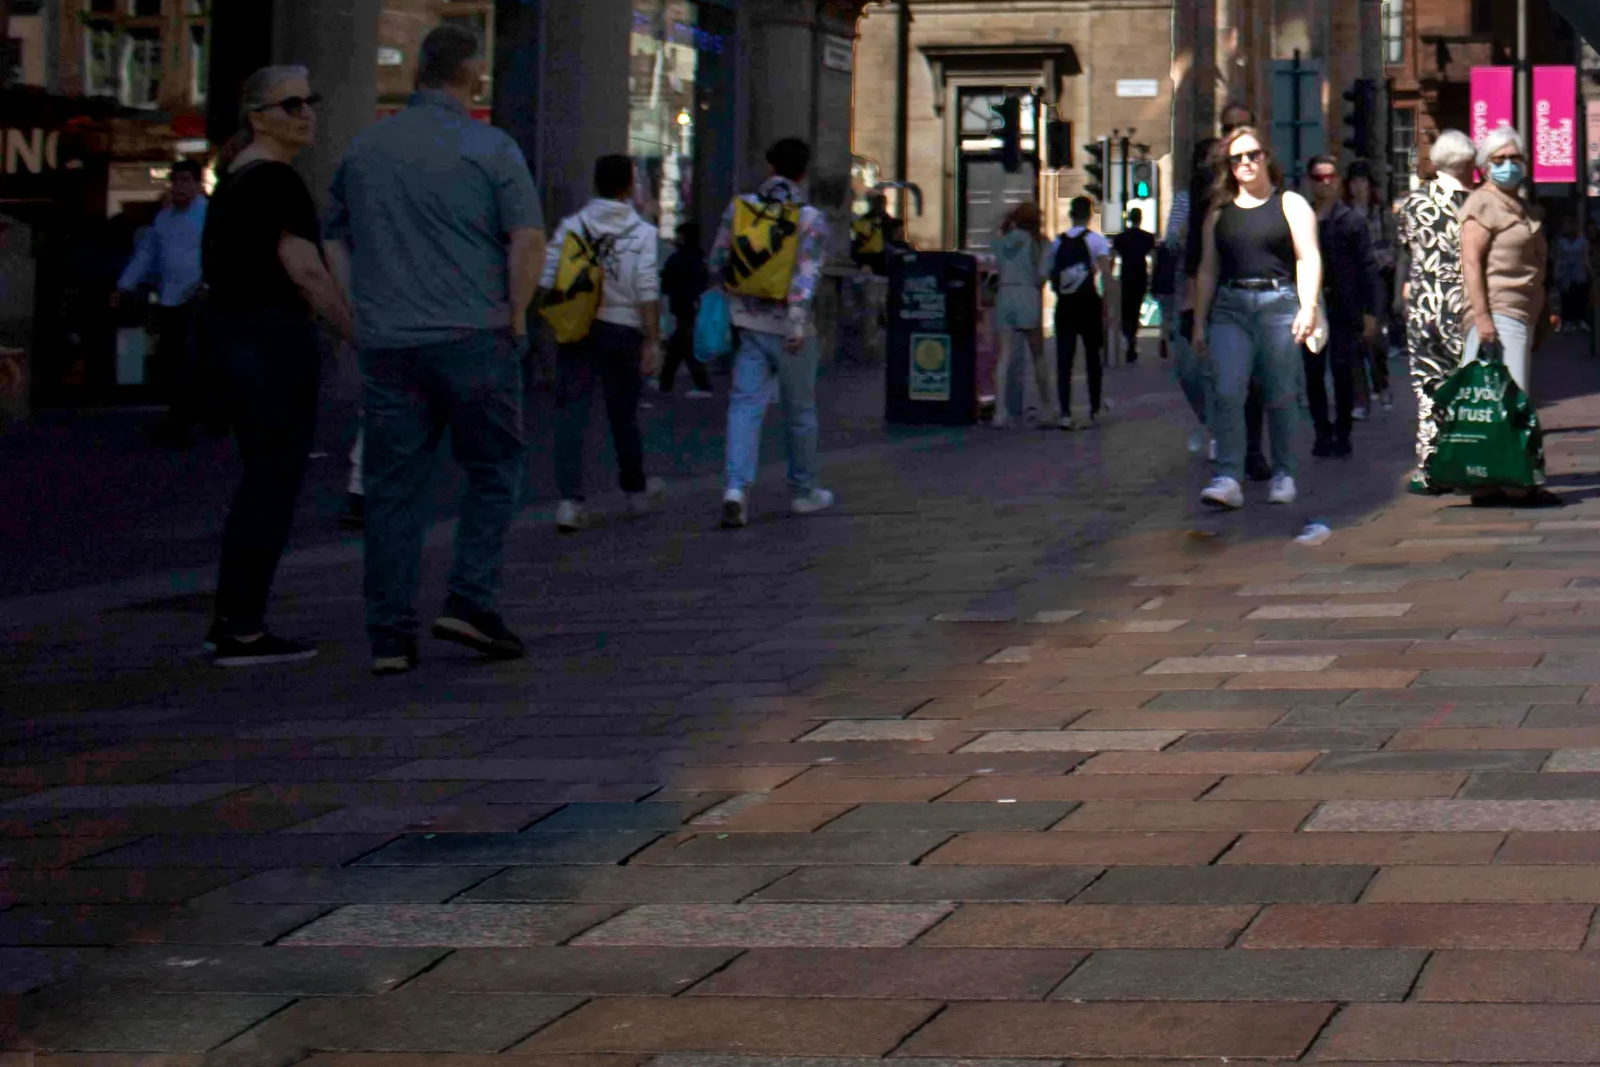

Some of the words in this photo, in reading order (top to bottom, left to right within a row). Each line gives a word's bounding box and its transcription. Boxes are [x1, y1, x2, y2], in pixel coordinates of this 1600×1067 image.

[1537, 100, 1550, 166] GLASGOW
[1550, 129, 1560, 166] MAKE
[1559, 119, 1573, 166] PEOPLE
[1458, 406, 1493, 423] trust
